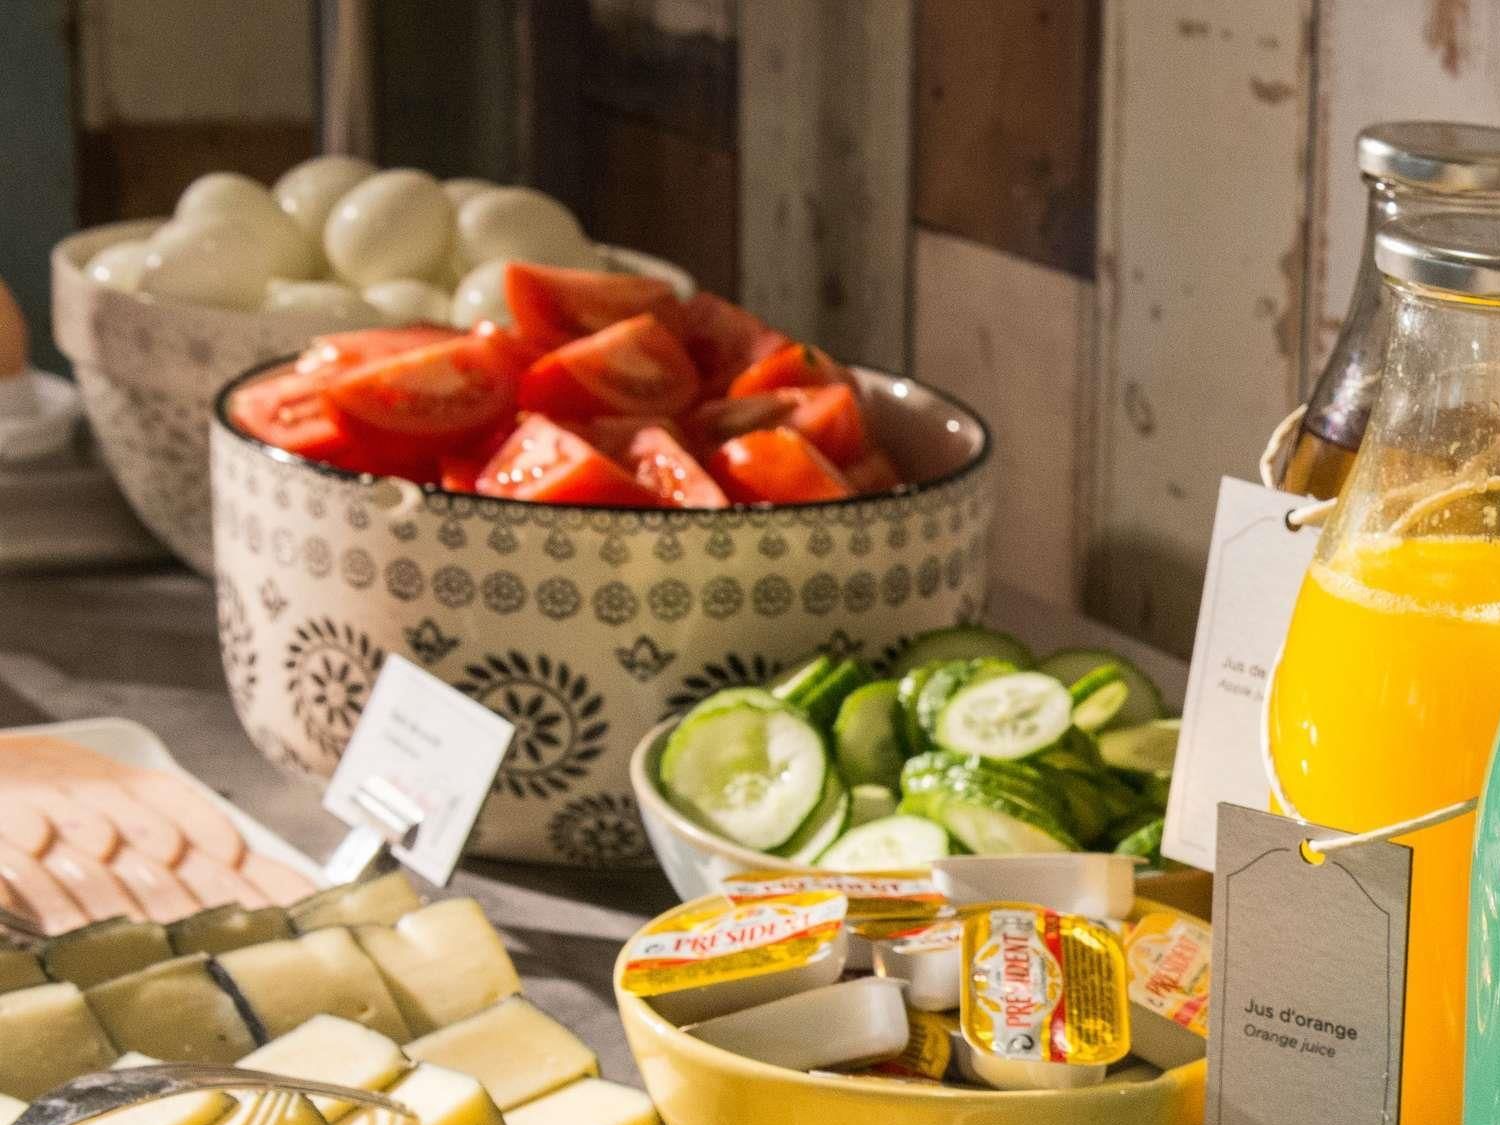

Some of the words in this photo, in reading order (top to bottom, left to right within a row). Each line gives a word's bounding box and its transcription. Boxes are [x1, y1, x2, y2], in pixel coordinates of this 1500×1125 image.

[1001, 932, 1032, 1029] PRÉIDENT
[1244, 999, 1273, 1019] Jus
[1279, 1008, 1357, 1040] d'orange
[1244, 1024, 1297, 1048] Orange
[1301, 1038, 1336, 1057] juice
